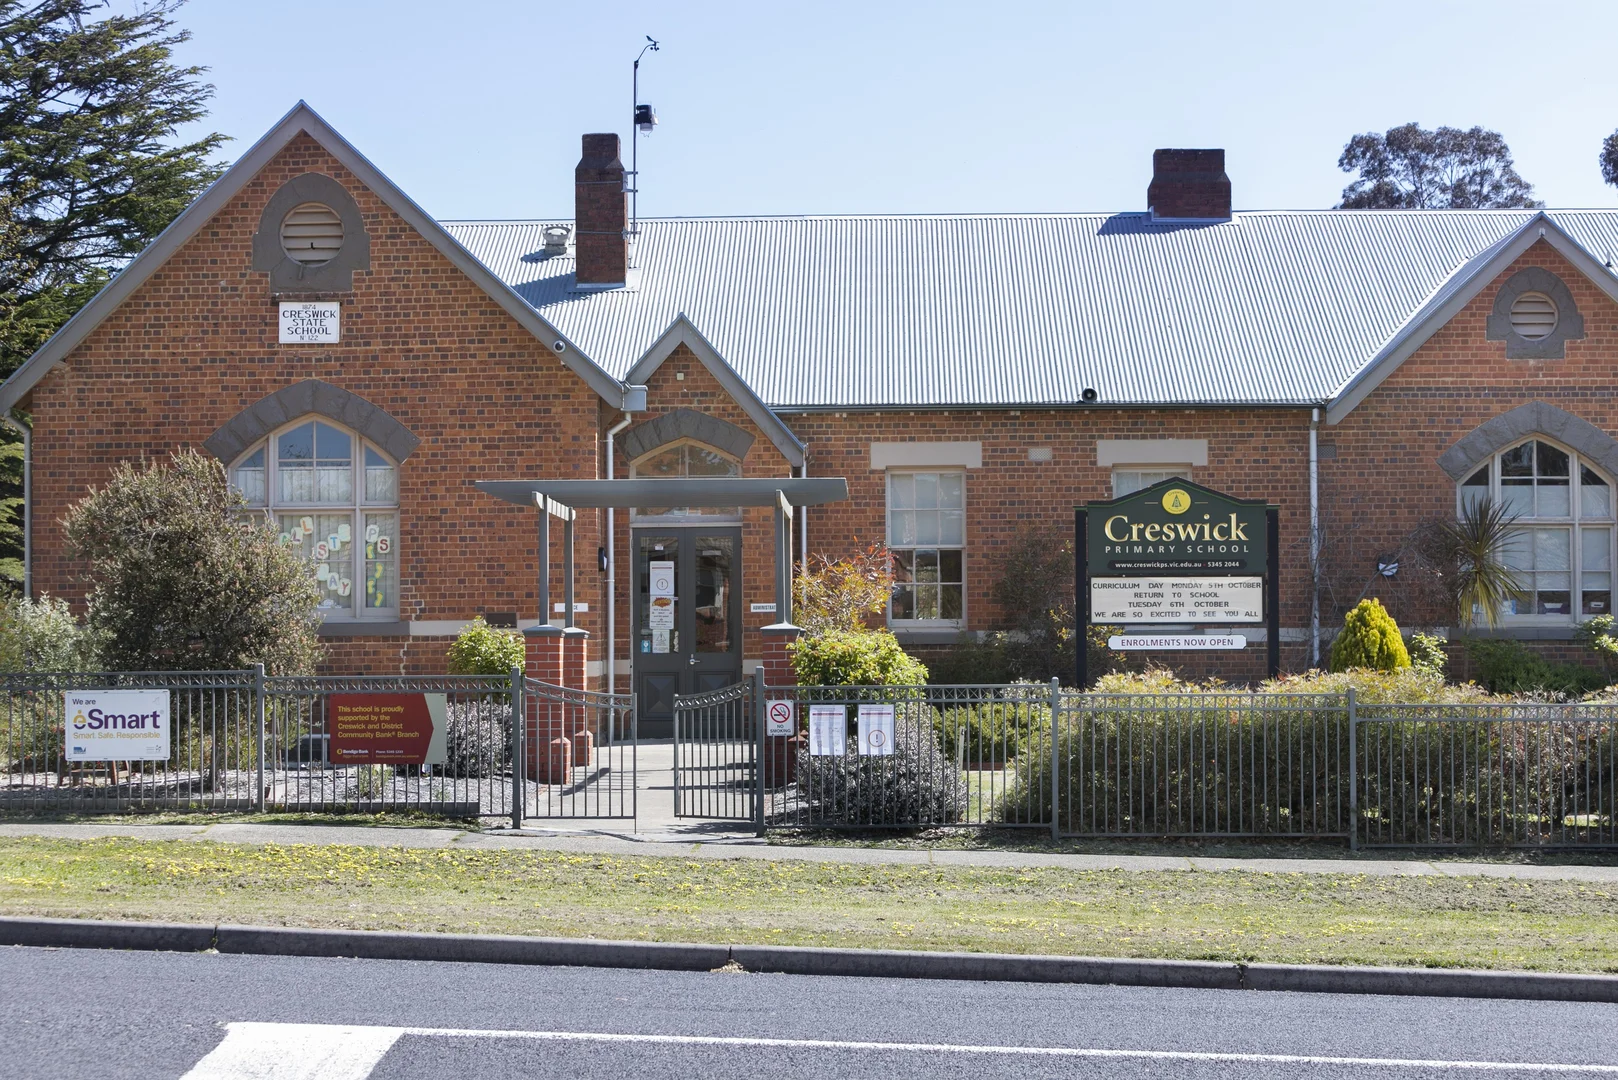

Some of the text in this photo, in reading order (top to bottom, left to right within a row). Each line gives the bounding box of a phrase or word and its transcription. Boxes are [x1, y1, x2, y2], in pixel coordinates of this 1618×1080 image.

[282, 310, 336, 318] CRESWICK
[292, 318, 326, 326] STATE
[287, 327, 331, 335] SCHOOL
[1104, 512, 1250, 543] Creswick
[318, 526, 389, 558] STPS
[1105, 545, 1249, 554] PRIMARY SCHOOL
[1115, 561, 1202, 570] www.creswickps.vic.edu.au
[1092, 582, 1140, 590] CURRICULUM
[1148, 582, 1164, 590] DAY
[1121, 638, 1234, 647] ENROLMENTS NOW OPEN
[338, 705, 404, 714] This school is proudly
[338, 714, 369, 722] supported
[371, 714, 379, 722] by
[338, 732, 374, 740] Community
